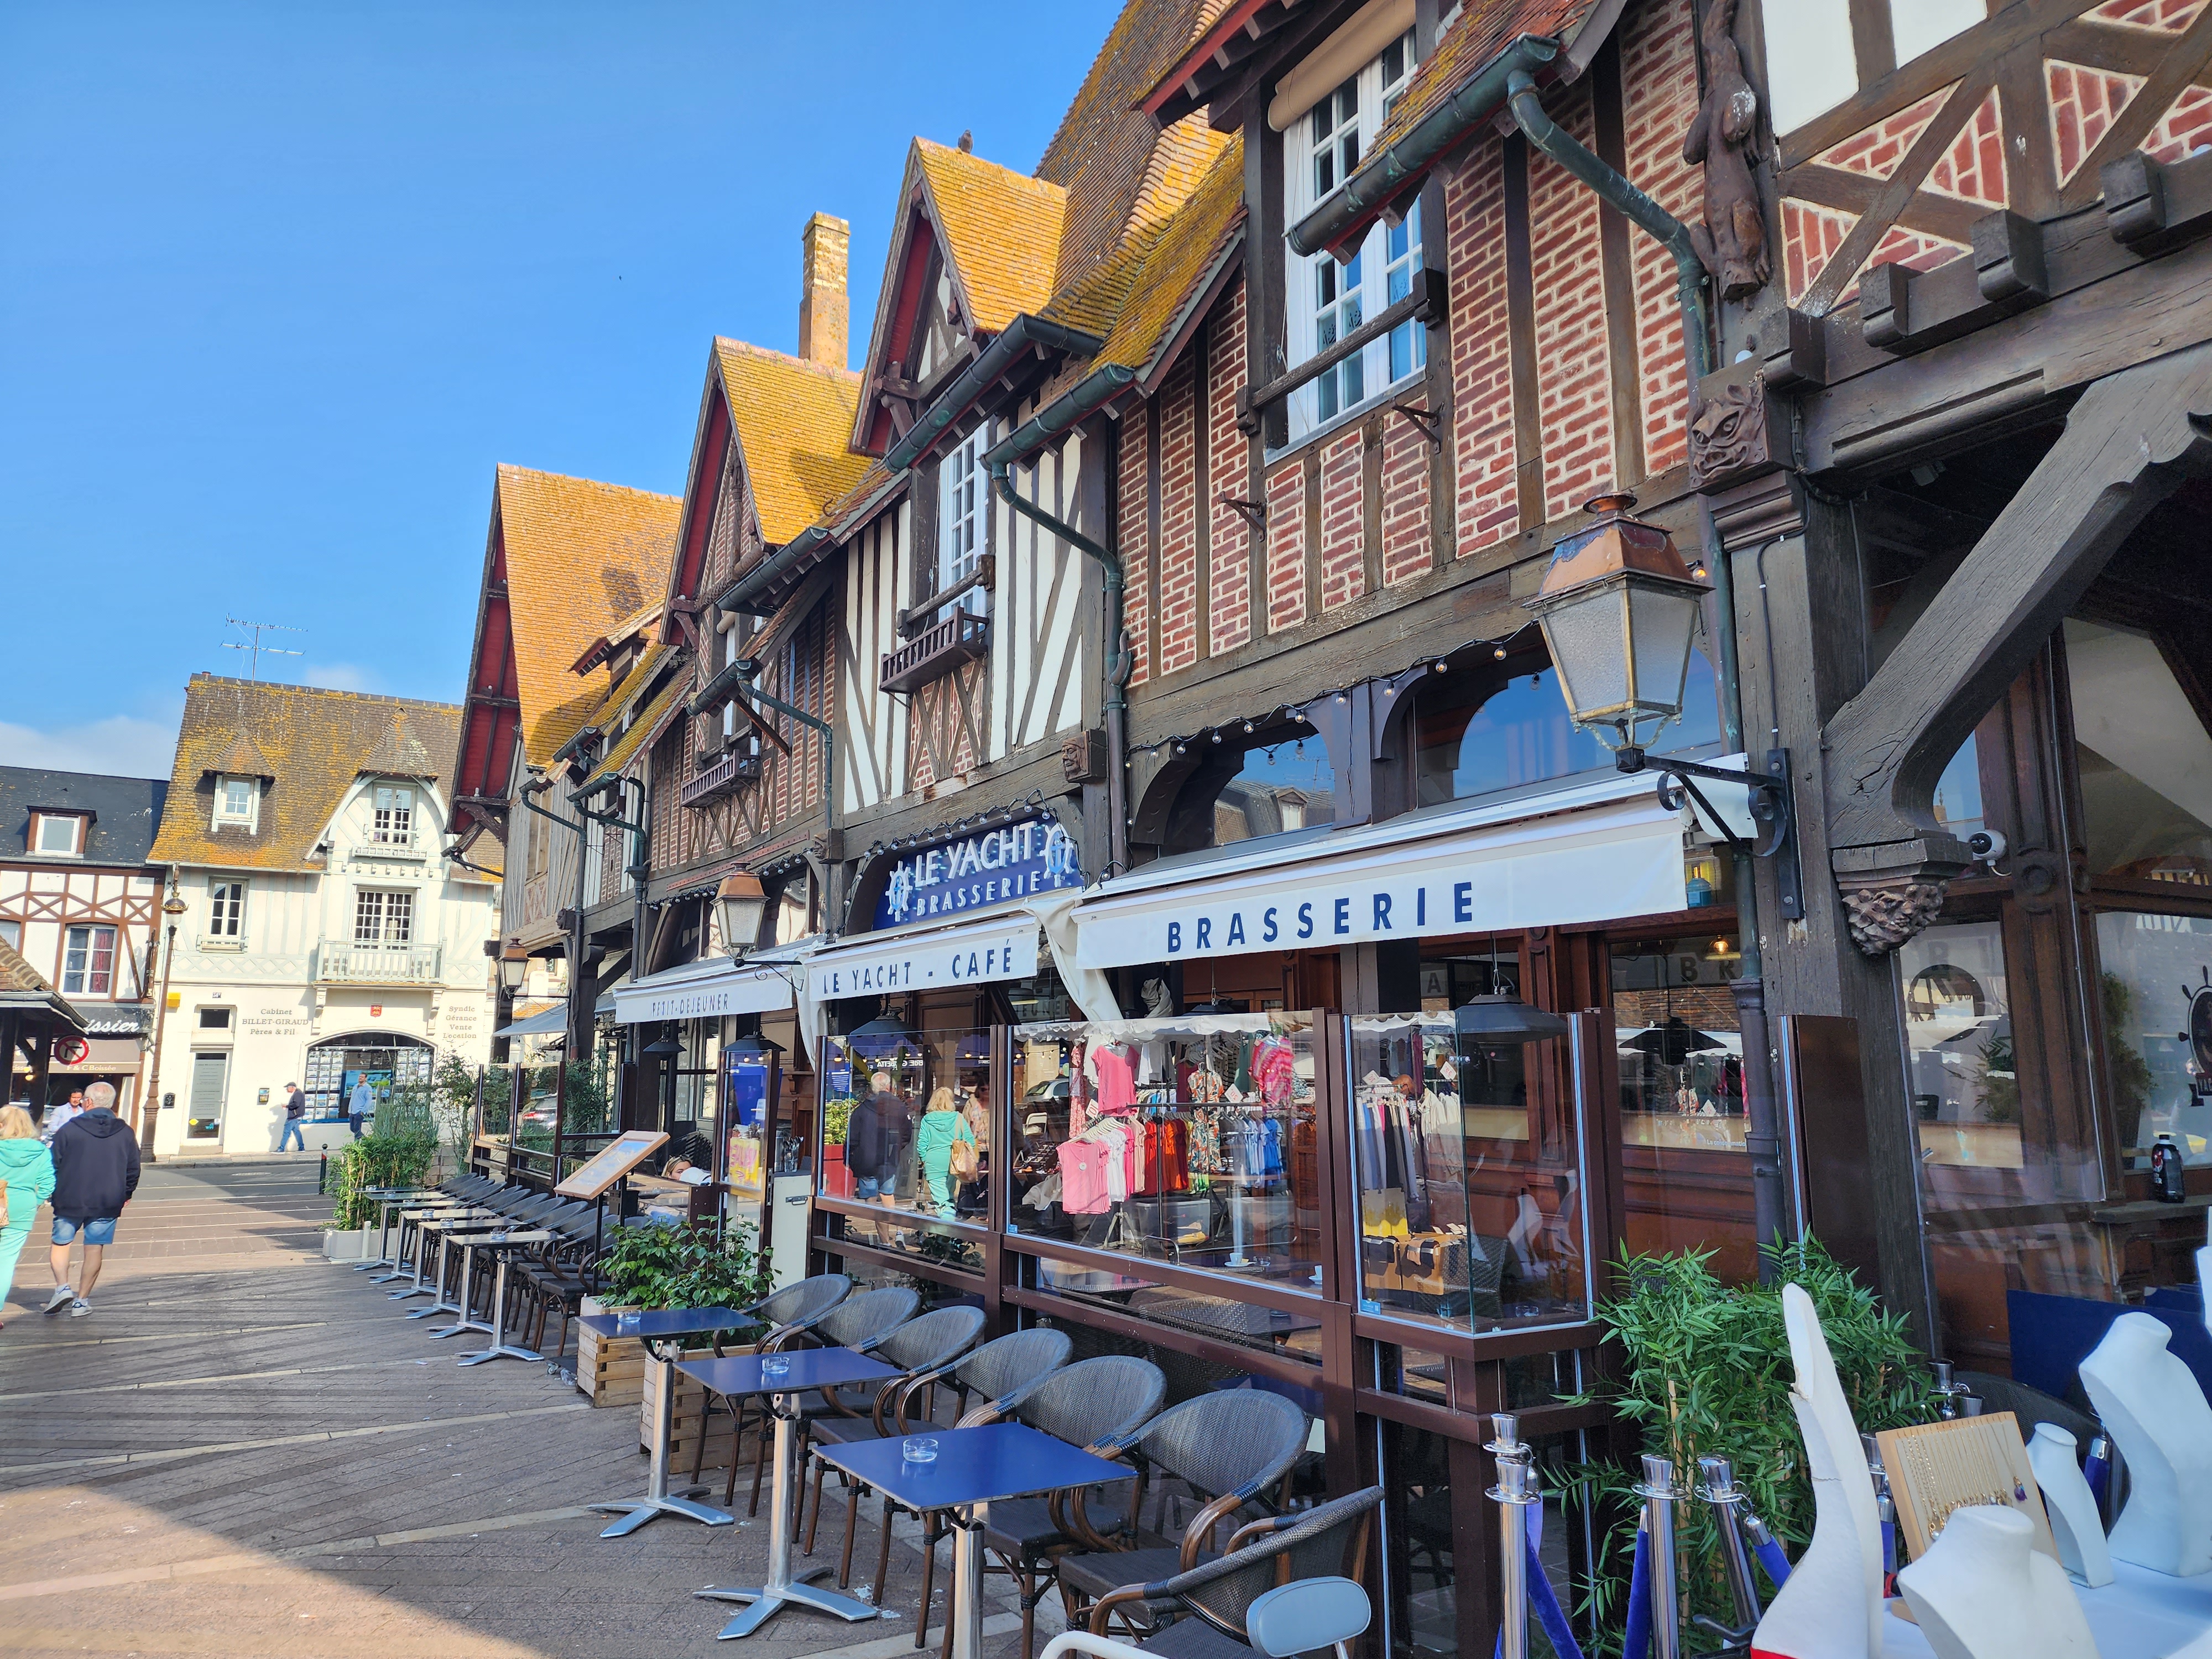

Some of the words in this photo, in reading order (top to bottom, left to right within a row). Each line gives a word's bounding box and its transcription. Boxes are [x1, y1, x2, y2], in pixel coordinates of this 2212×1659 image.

[915, 849, 940, 888] LE
[946, 821, 1037, 879] YACHT
[916, 870, 1041, 916] BRASSERIE
[1167, 881, 1473, 953] BRASSERIE
[823, 973, 839, 994] LE
[852, 961, 911, 990] YACHT
[951, 938, 1012, 979] CAFÉ
[84, 1019, 139, 1032] issier
[652, 993, 729, 1016] PETIT-DÉJEUNER
